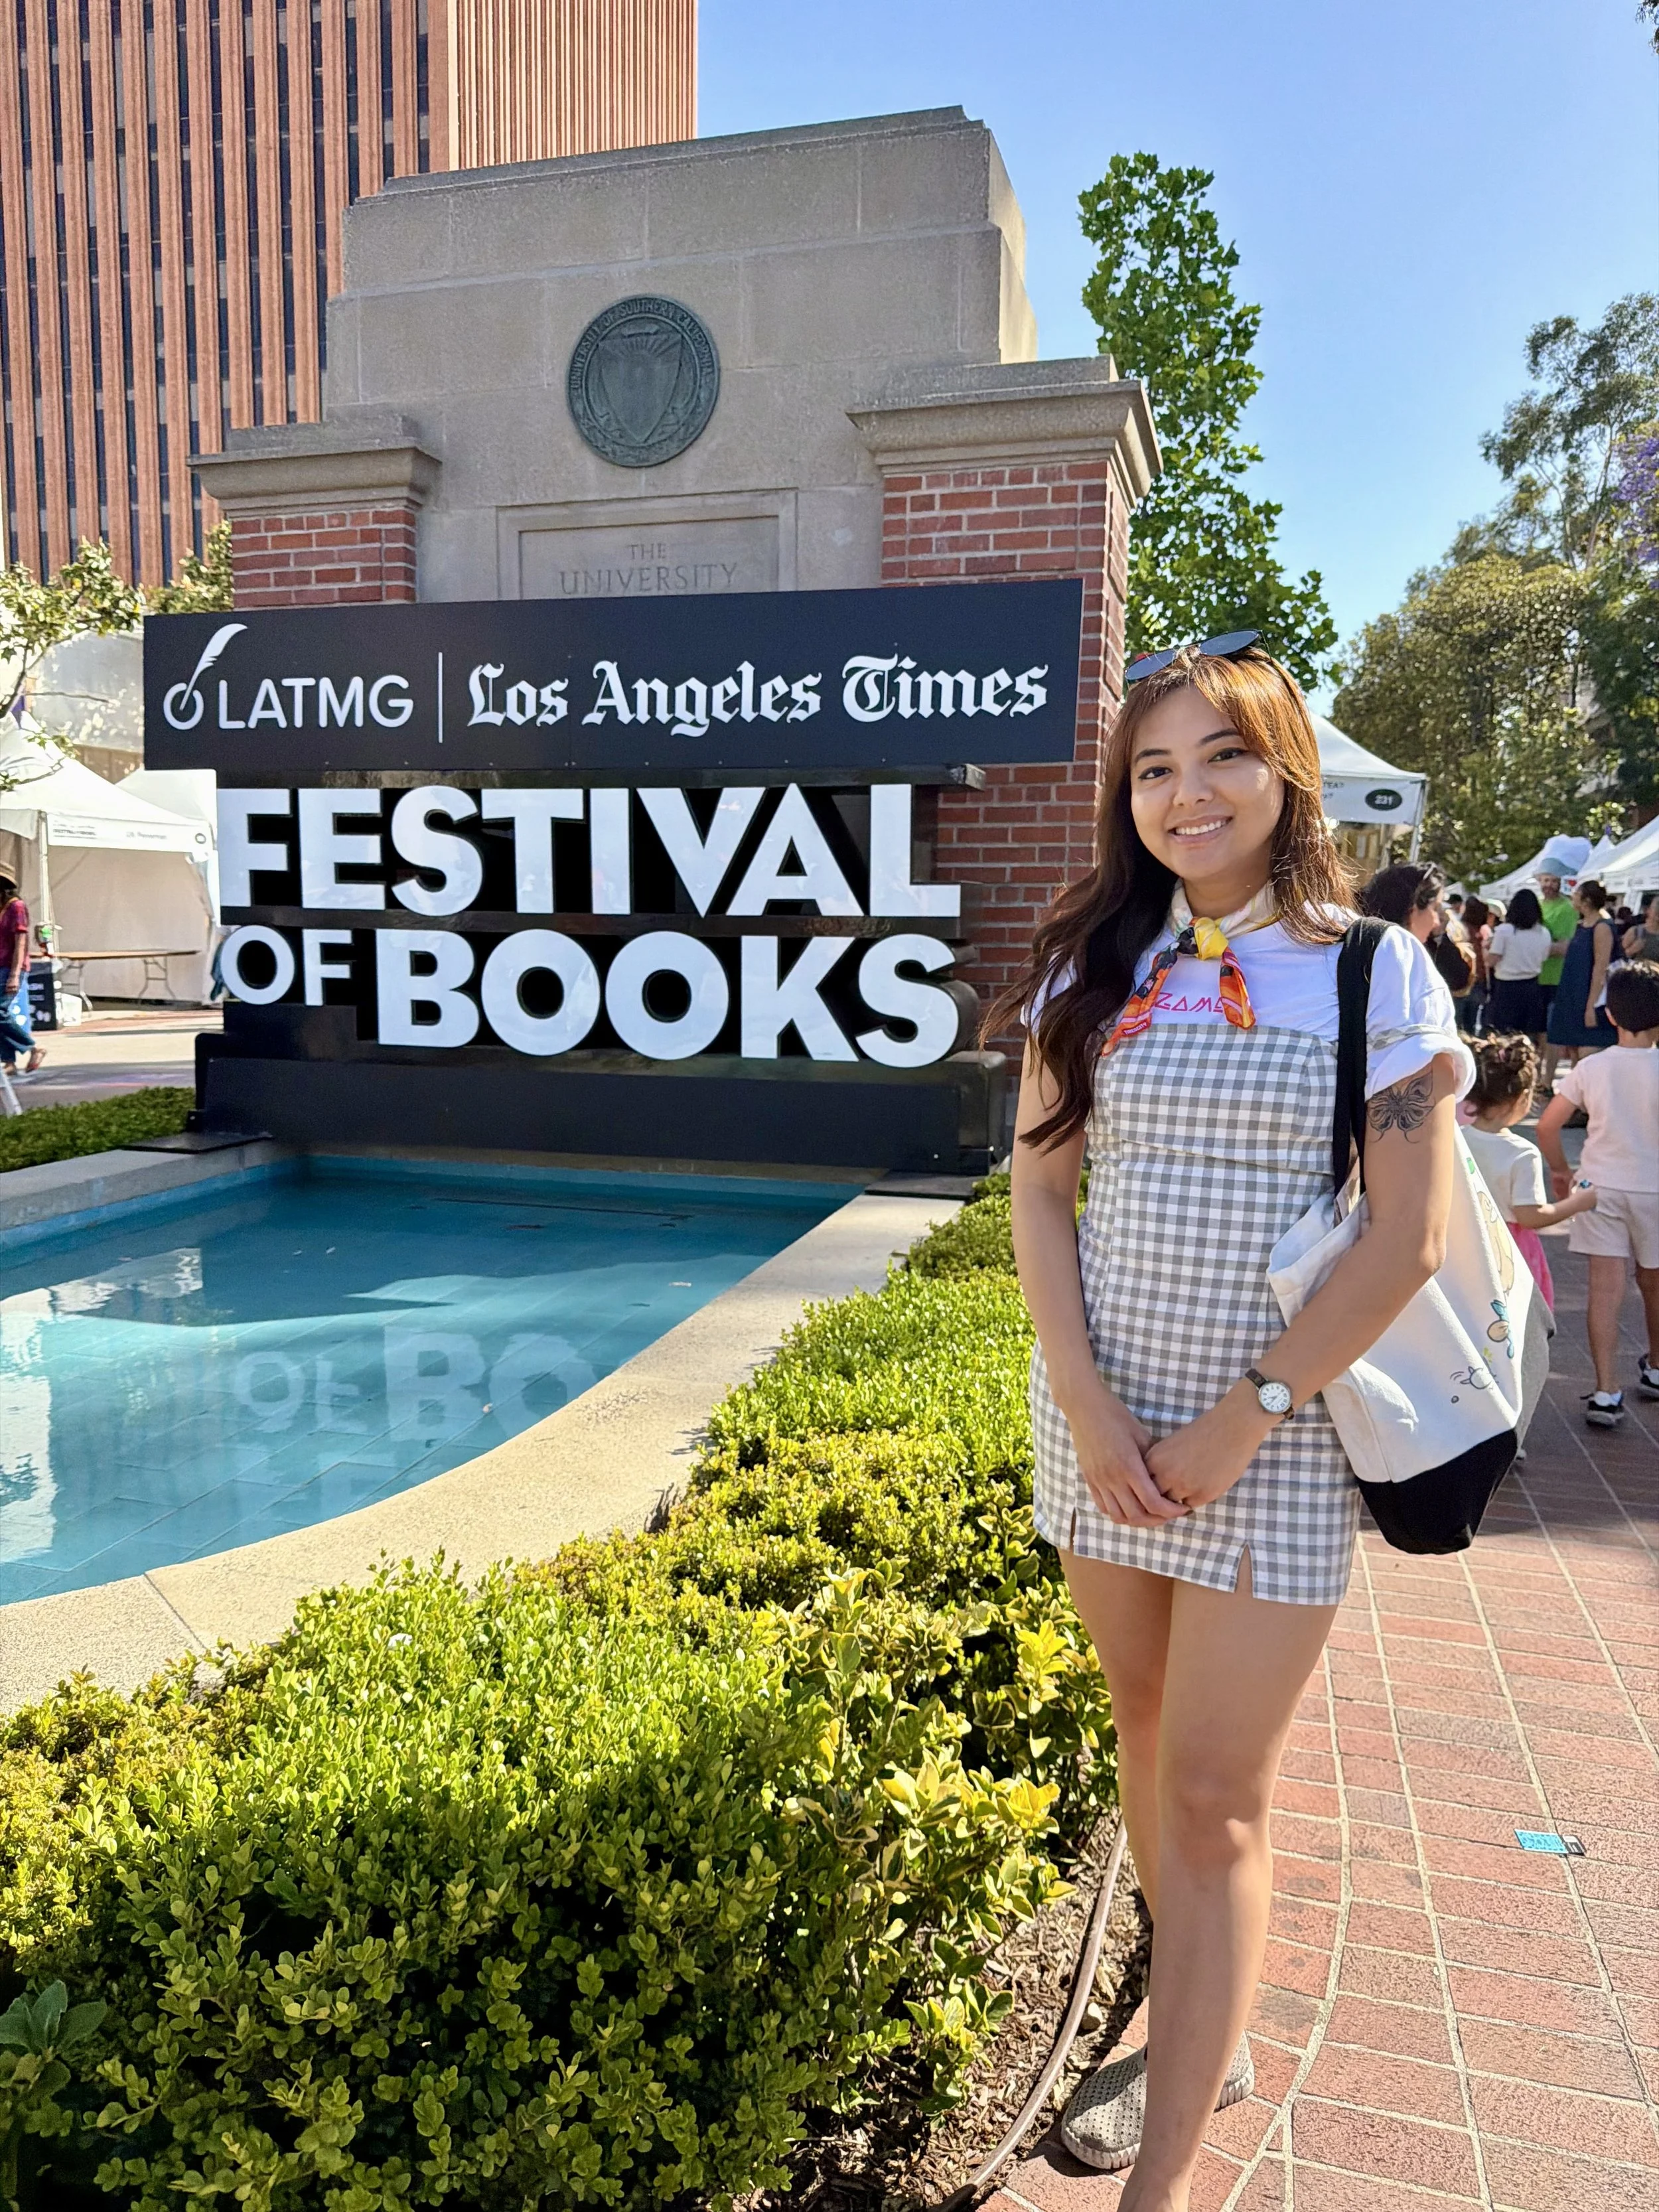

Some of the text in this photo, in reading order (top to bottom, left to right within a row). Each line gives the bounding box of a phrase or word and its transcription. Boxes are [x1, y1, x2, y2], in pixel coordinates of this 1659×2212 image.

[559, 563, 739, 595] UNIVERSITY
[627, 543, 668, 561] THE
[219, 654, 1049, 737] LATMG Los Angeles Times
[217, 782, 961, 919] FESTIVAL
[220, 924, 960, 1069] OF BOOKS
